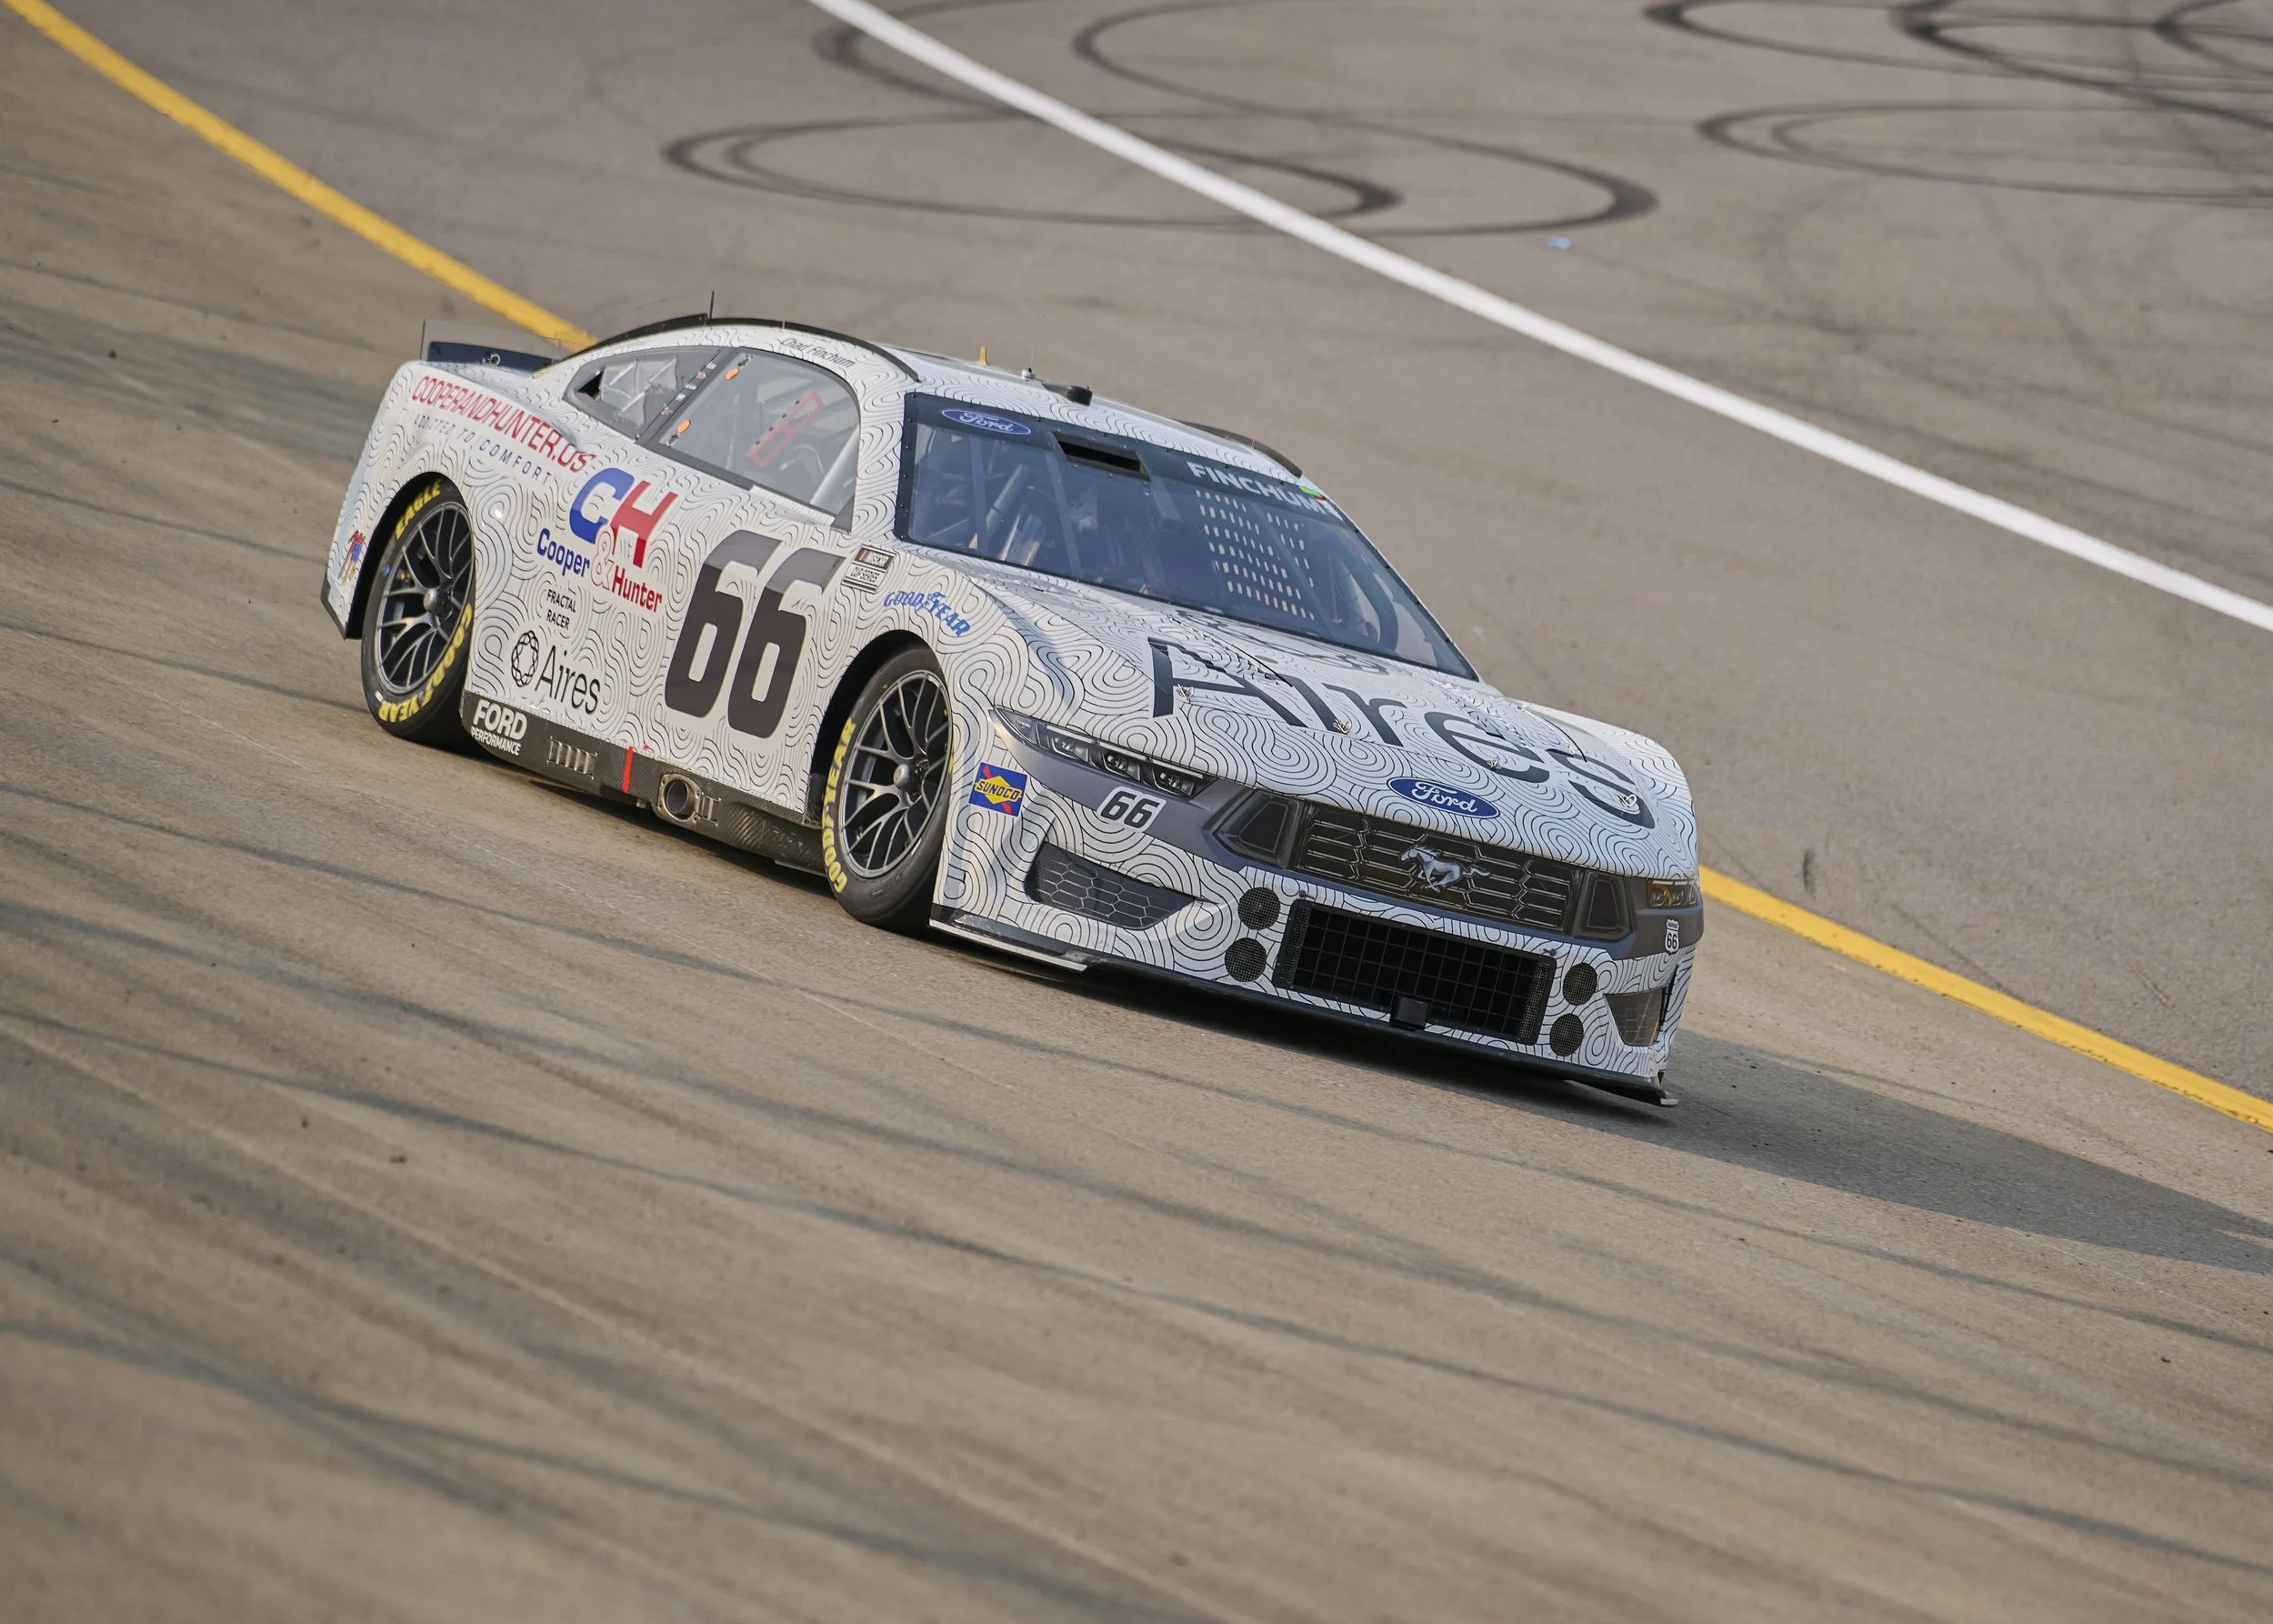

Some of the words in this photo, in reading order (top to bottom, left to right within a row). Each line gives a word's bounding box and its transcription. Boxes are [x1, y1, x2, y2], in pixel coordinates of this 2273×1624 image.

[806, 346, 856, 368] Finchum
[412, 376, 597, 473] COOPERANDHUNTER.US
[959, 412, 1015, 432] Ford
[456, 428, 476, 443] TO
[479, 439, 552, 486] COMFORT
[396, 478, 443, 540] EAGLE
[1187, 461, 1344, 523] FINCHUM
[536, 527, 590, 578] Cooper
[591, 530, 615, 591] &
[611, 565, 664, 613] Hunter
[546, 588, 576, 614] FRACTAL
[546, 609, 570, 630] RACER
[665, 529, 846, 738] 66
[535, 645, 601, 715] Aires
[472, 697, 527, 740] FORD
[1147, 636, 1656, 830] Aires
[471, 726, 522, 757] PERFORMANCE
[976, 780, 1020, 800] SUNOCO
[1100, 790, 1161, 828] 66
[1411, 781, 1477, 813] Ford
[1667, 932, 1678, 950] 66
